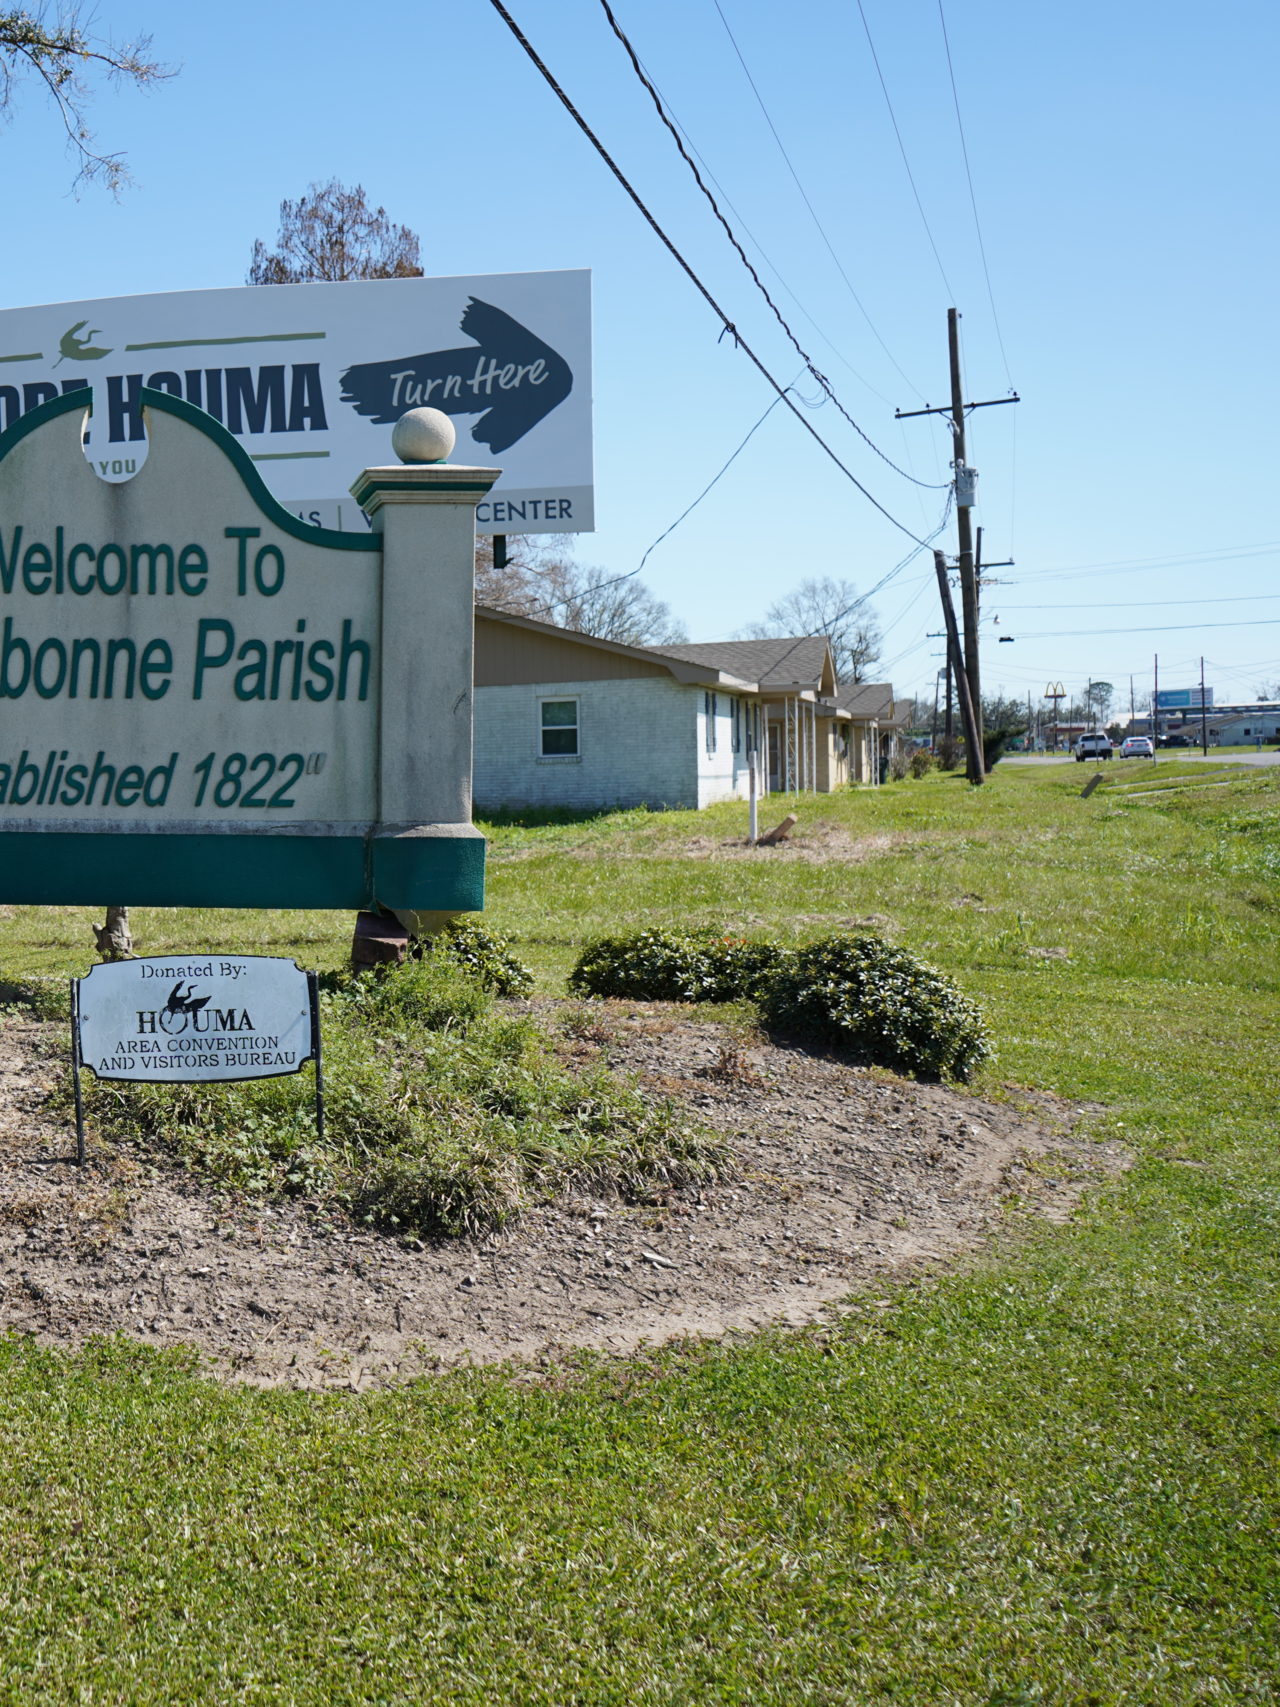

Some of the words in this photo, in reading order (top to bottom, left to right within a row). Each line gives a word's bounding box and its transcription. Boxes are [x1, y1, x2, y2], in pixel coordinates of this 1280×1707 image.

[390, 369, 461, 407] Turn
[467, 356, 549, 395] Here
[476, 499, 573, 523] CENTER
[225, 527, 286, 597] To
[193, 618, 372, 701] Parish
[141, 963, 214, 978] Donated
[220, 962, 247, 980] By:
[136, 1007, 255, 1035] HOUMA
[115, 1040, 161, 1054] AREA
[167, 1036, 279, 1051] CONVENTION
[99, 1057, 135, 1070] AND
[141, 1054, 219, 1069] VISITORS
[225, 1052, 296, 1067] BUREAU
